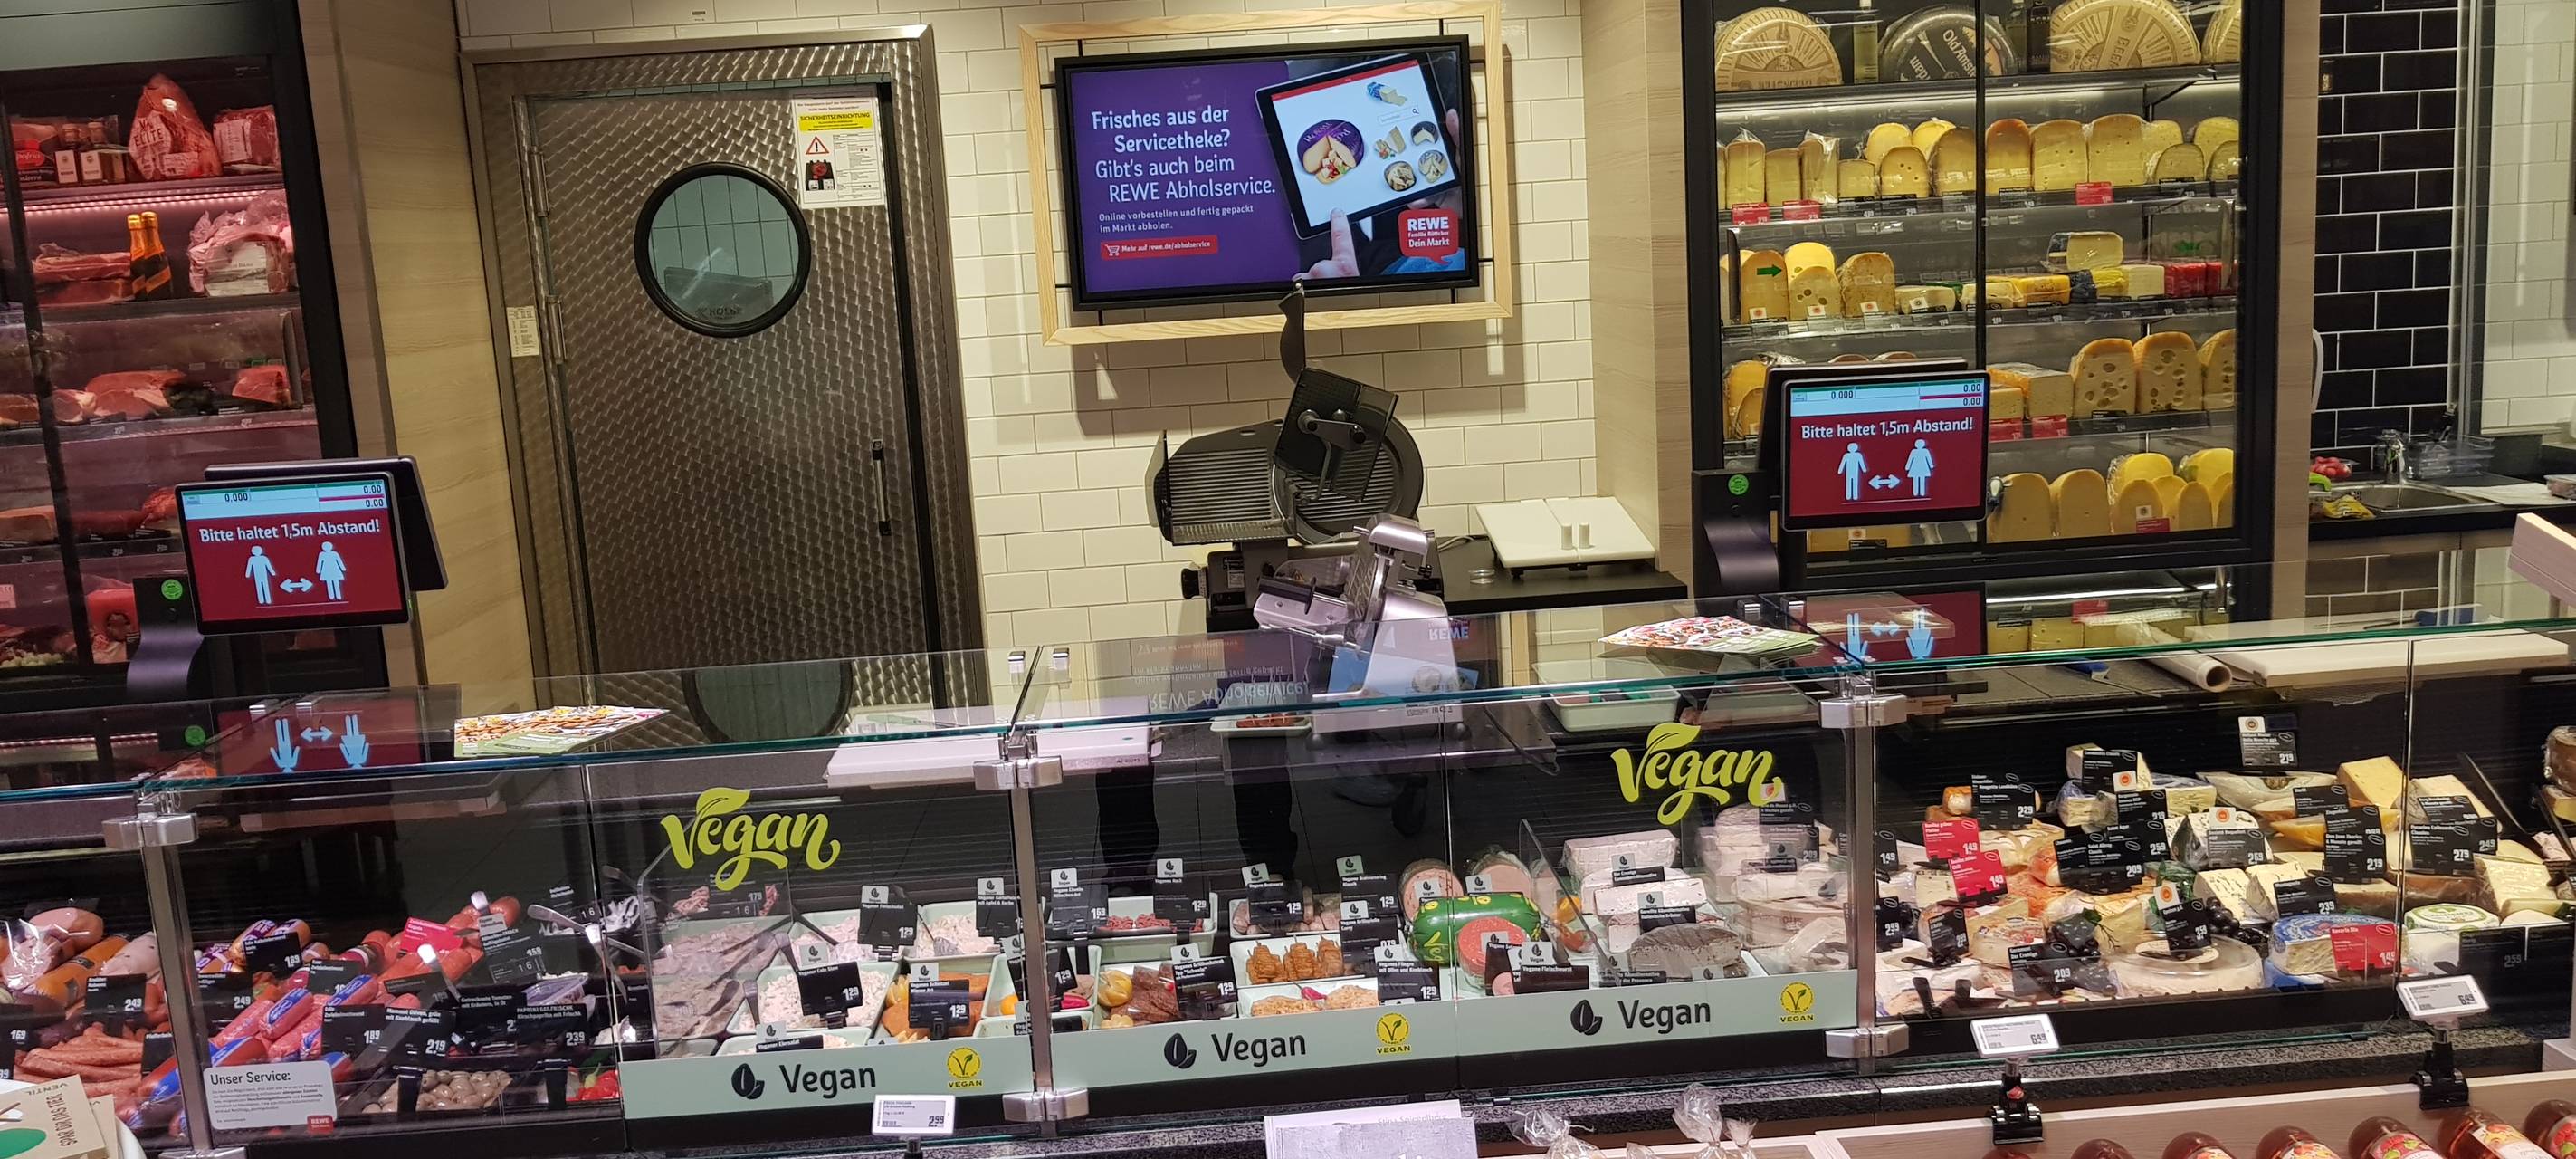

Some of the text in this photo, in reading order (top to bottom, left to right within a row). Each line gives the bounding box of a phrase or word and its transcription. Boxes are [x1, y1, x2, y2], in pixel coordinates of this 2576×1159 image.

[1092, 105, 1229, 130] Frisches aus der
[1114, 129, 1231, 153] Servicetheke?
[1095, 154, 1235, 179] Gibt's auch beim
[1110, 177, 1276, 203] REWE Abholservice.
[1099, 205, 1254, 222] Online vorbestellen und fertig gepackt
[1100, 222, 1173, 233] im Markt abholen.
[1407, 216, 1449, 232] REWE
[1121, 244, 1136, 253] Mehr
[1138, 244, 1148, 252] auf
[1408, 237, 1450, 247] Dein Markt
[1830, 390, 1854, 399] 0.000
[1963, 384, 1981, 392] 0.00
[1963, 398, 1980, 406] 0.00
[1801, 417, 1974, 439] Bitte haltet 1,5m Abstand!
[363, 484, 382, 494] 0.00
[224, 493, 248, 503] 0.000
[365, 498, 384, 508] 0.00
[199, 520, 380, 542] Bitte haltet 1,5m Abstand!
[1611, 729, 1782, 825] Vegan
[660, 793, 842, 890] Vegan
[1617, 999, 1711, 1034] Vegan
[1779, 1014, 1815, 1023] VEGAN
[1211, 1032, 1306, 1067] Vegan
[1376, 1045, 1411, 1054] VEGAN
[210, 1070, 291, 1085] Unser Service:
[779, 1064, 876, 1098] Vegan
